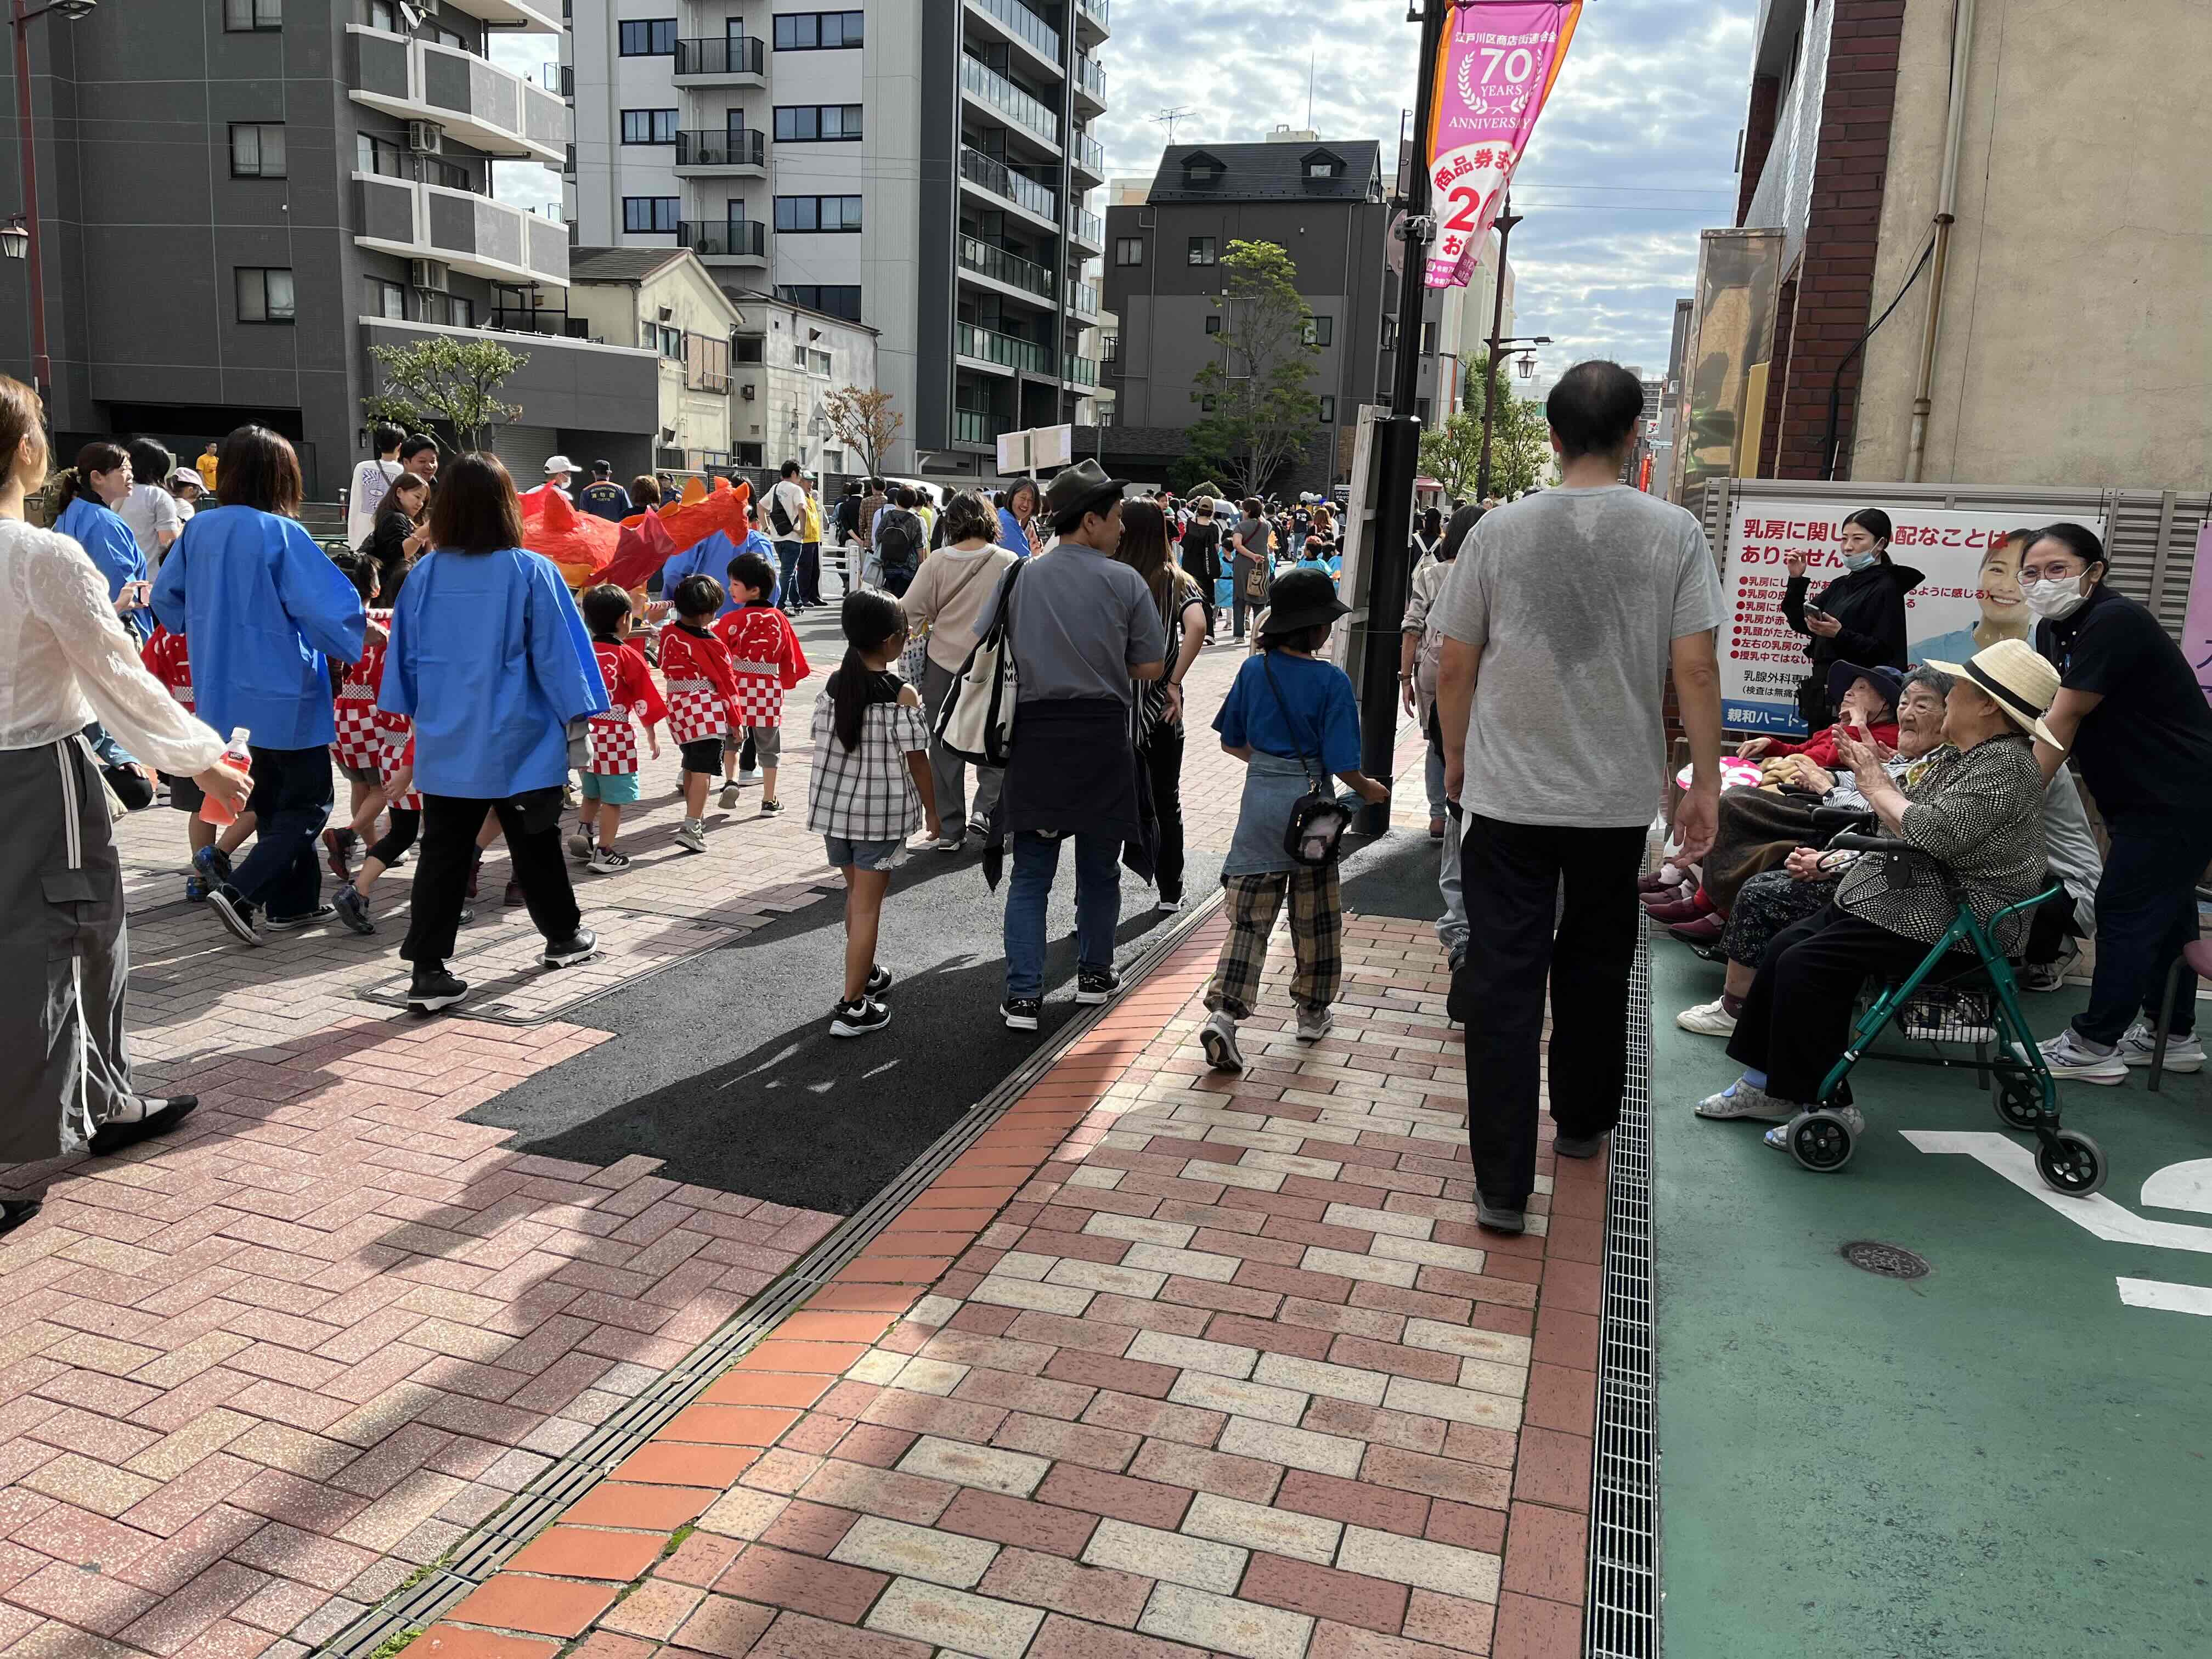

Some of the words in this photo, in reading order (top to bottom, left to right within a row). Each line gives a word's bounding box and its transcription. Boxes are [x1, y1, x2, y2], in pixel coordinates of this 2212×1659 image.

[1480, 48, 1532, 84] 70
[1481, 84, 1523, 97] YEARS
[1448, 116, 1534, 129] ANNIVERSY
